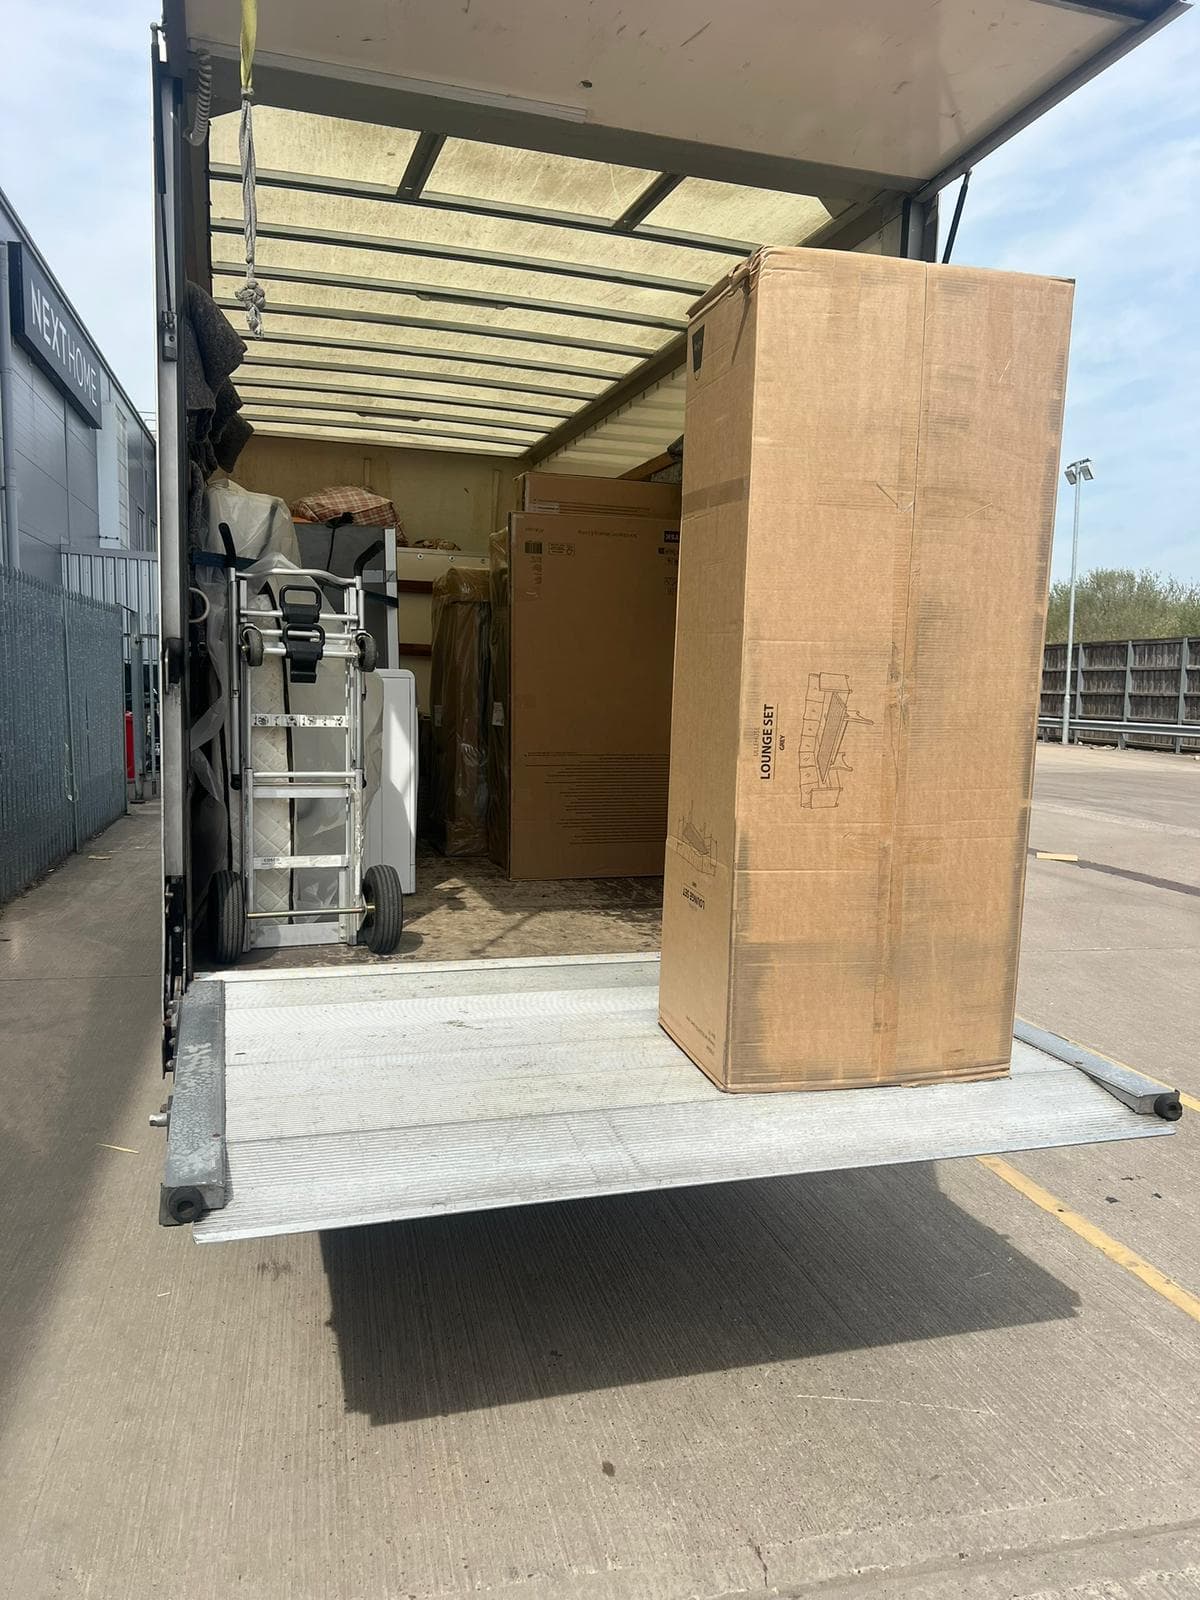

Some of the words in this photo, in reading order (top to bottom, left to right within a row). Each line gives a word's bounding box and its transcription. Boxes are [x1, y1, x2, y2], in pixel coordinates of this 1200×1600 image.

[31, 279, 67, 365] NEXT
[67, 334, 98, 406] HOME
[763, 703, 775, 727] SET
[760, 728, 774, 780] LOUNGE
